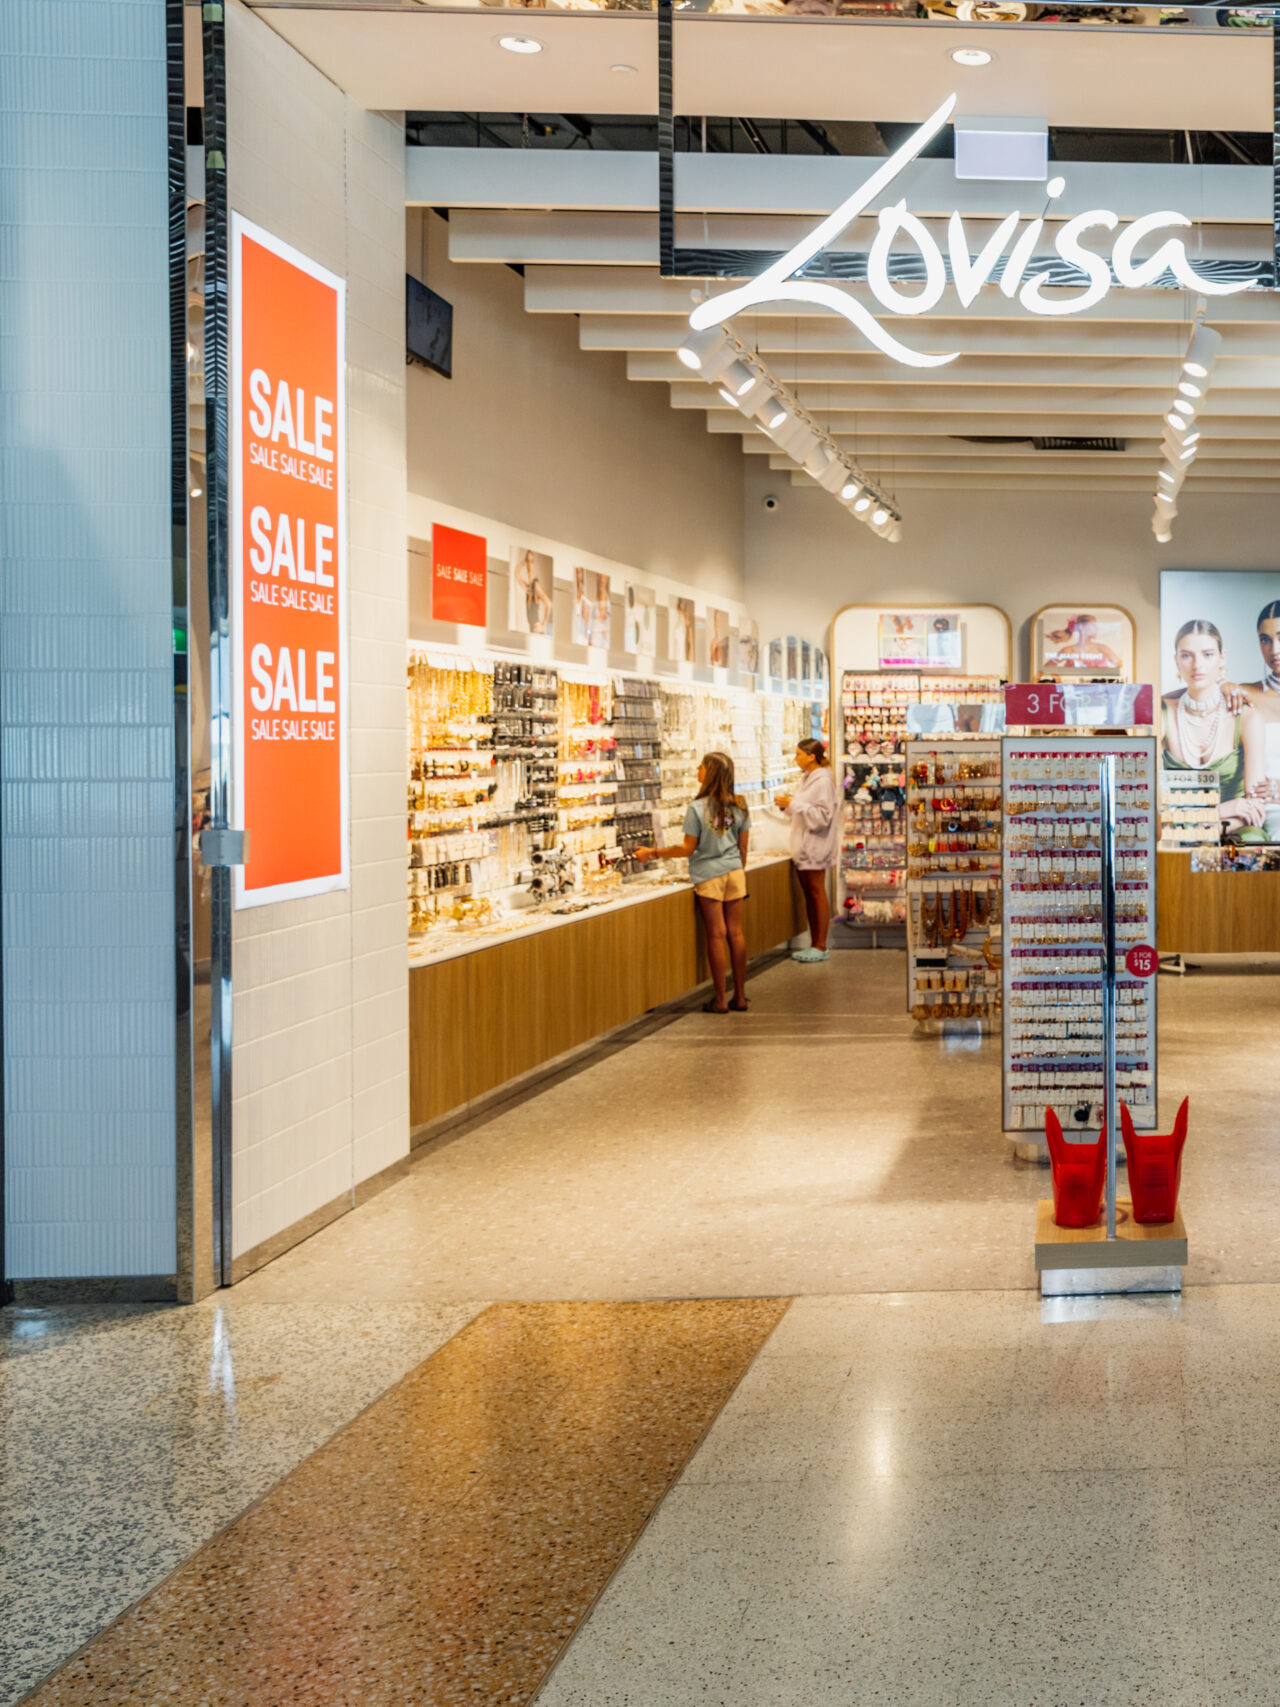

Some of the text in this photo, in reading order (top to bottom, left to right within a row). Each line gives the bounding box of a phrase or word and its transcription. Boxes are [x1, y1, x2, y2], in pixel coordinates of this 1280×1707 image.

[689, 92, 1259, 368] Lovisa
[249, 368, 334, 463] SALE
[250, 442, 334, 489] SALE SALE SALE
[249, 505, 335, 588] SALE
[436, 563, 484, 587] SALE SALE SALE
[250, 580, 335, 615] SALE SALE SALE
[250, 643, 336, 713] SALE
[1027, 693, 1040, 714] 3
[251, 718, 336, 741] SALE SALE SALE
[1133, 958, 1152, 971] $15
[1139, 951, 1152, 959] FOR
